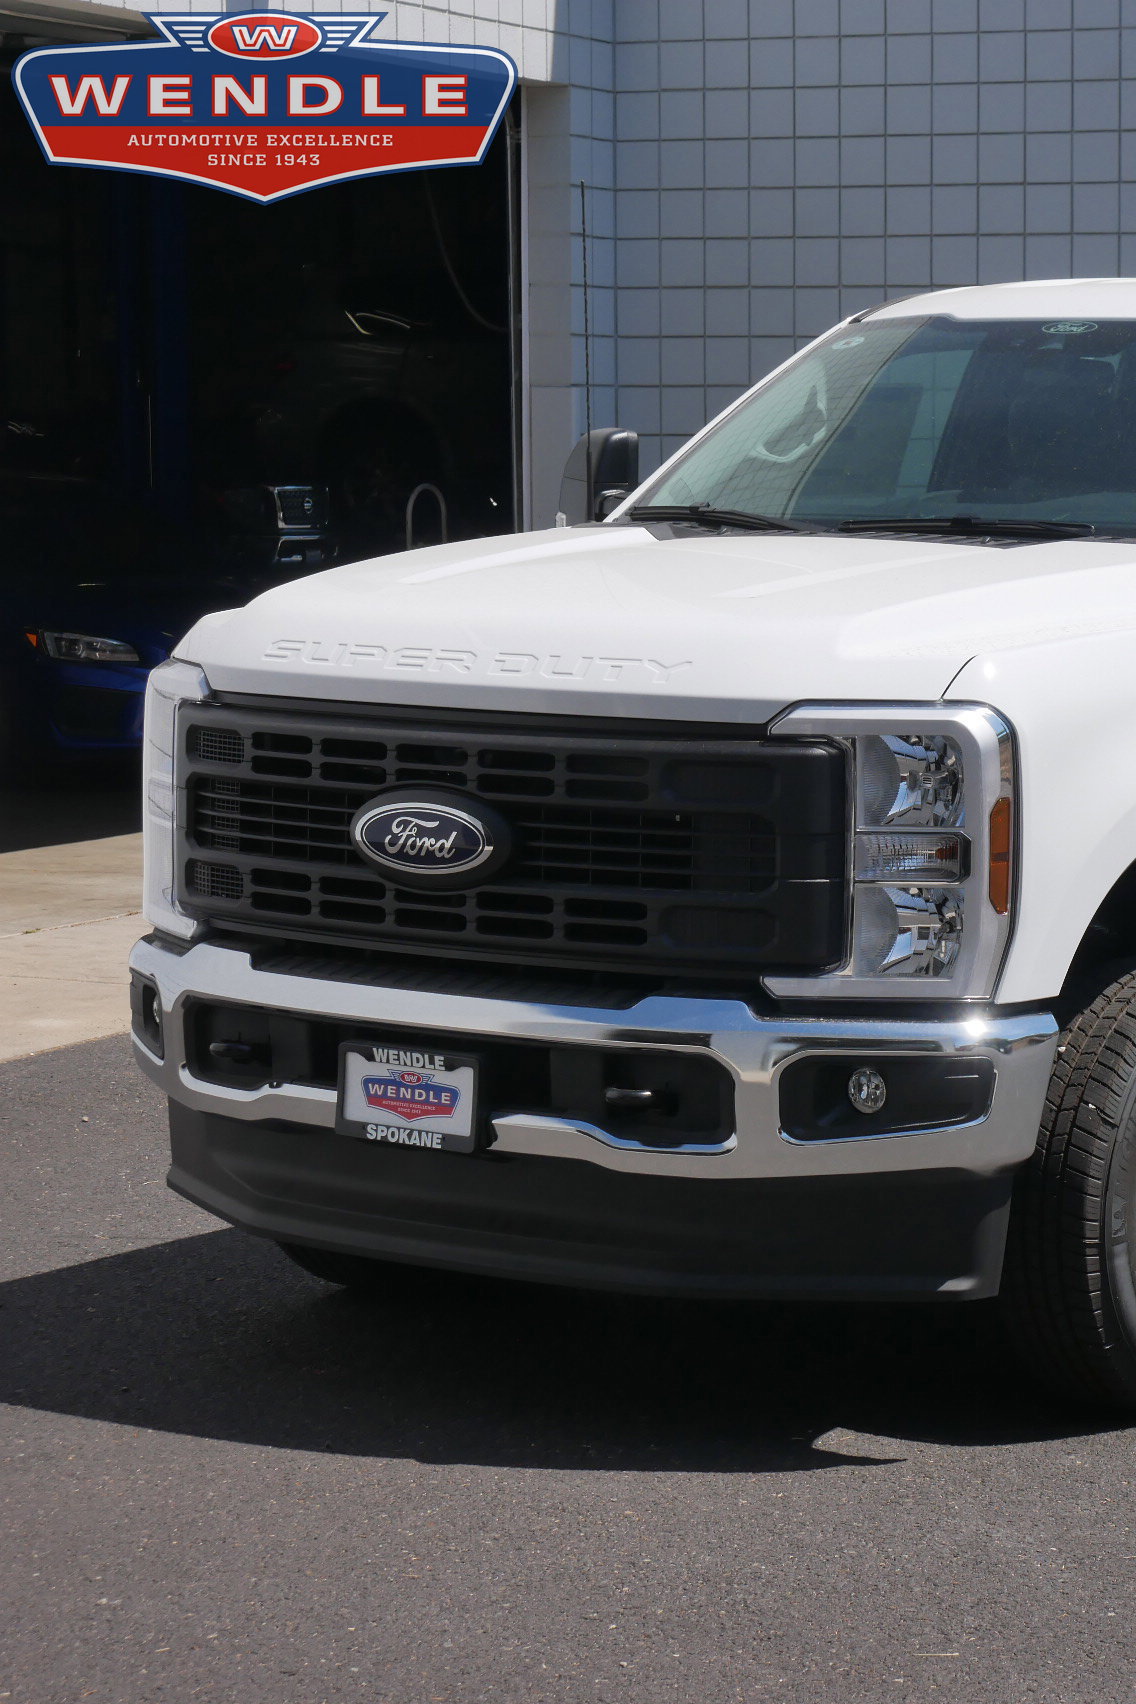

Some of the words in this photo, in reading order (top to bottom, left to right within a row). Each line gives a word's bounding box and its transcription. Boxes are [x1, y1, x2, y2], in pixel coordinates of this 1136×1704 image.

[261, 639, 478, 674] SUPER
[487, 652, 694, 684] DUTY
[384, 816, 458, 859] Ford
[372, 1047, 446, 1071] WENDLE
[368, 1083, 451, 1104] WENDLE
[366, 1123, 443, 1149] SPOKANE
